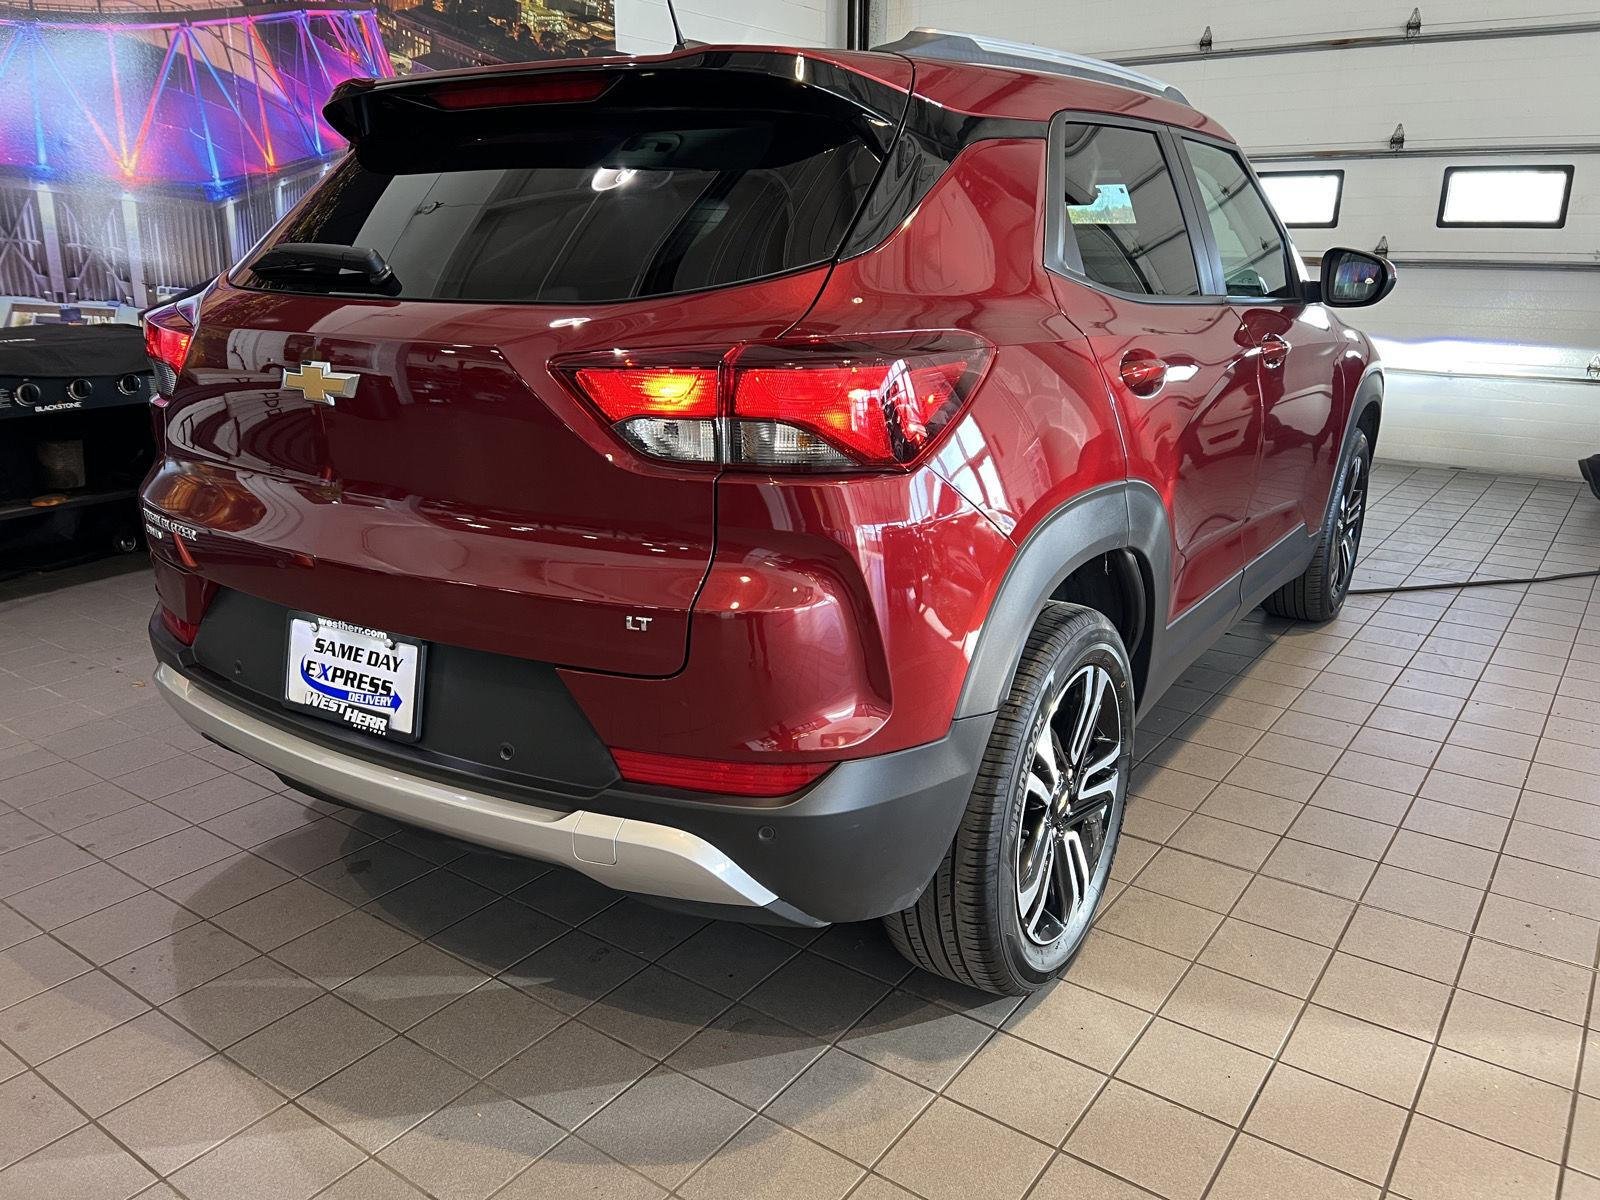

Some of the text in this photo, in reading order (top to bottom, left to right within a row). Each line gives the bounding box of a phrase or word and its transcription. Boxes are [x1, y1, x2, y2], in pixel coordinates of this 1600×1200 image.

[34, 401, 82, 413] BLACKSTONE
[317, 617, 388, 640] westherr.com
[626, 615, 653, 632] LT
[314, 638, 404, 673] SAME DAY
[305, 659, 394, 697] EXPRESS
[348, 693, 393, 707] DELIVERY
